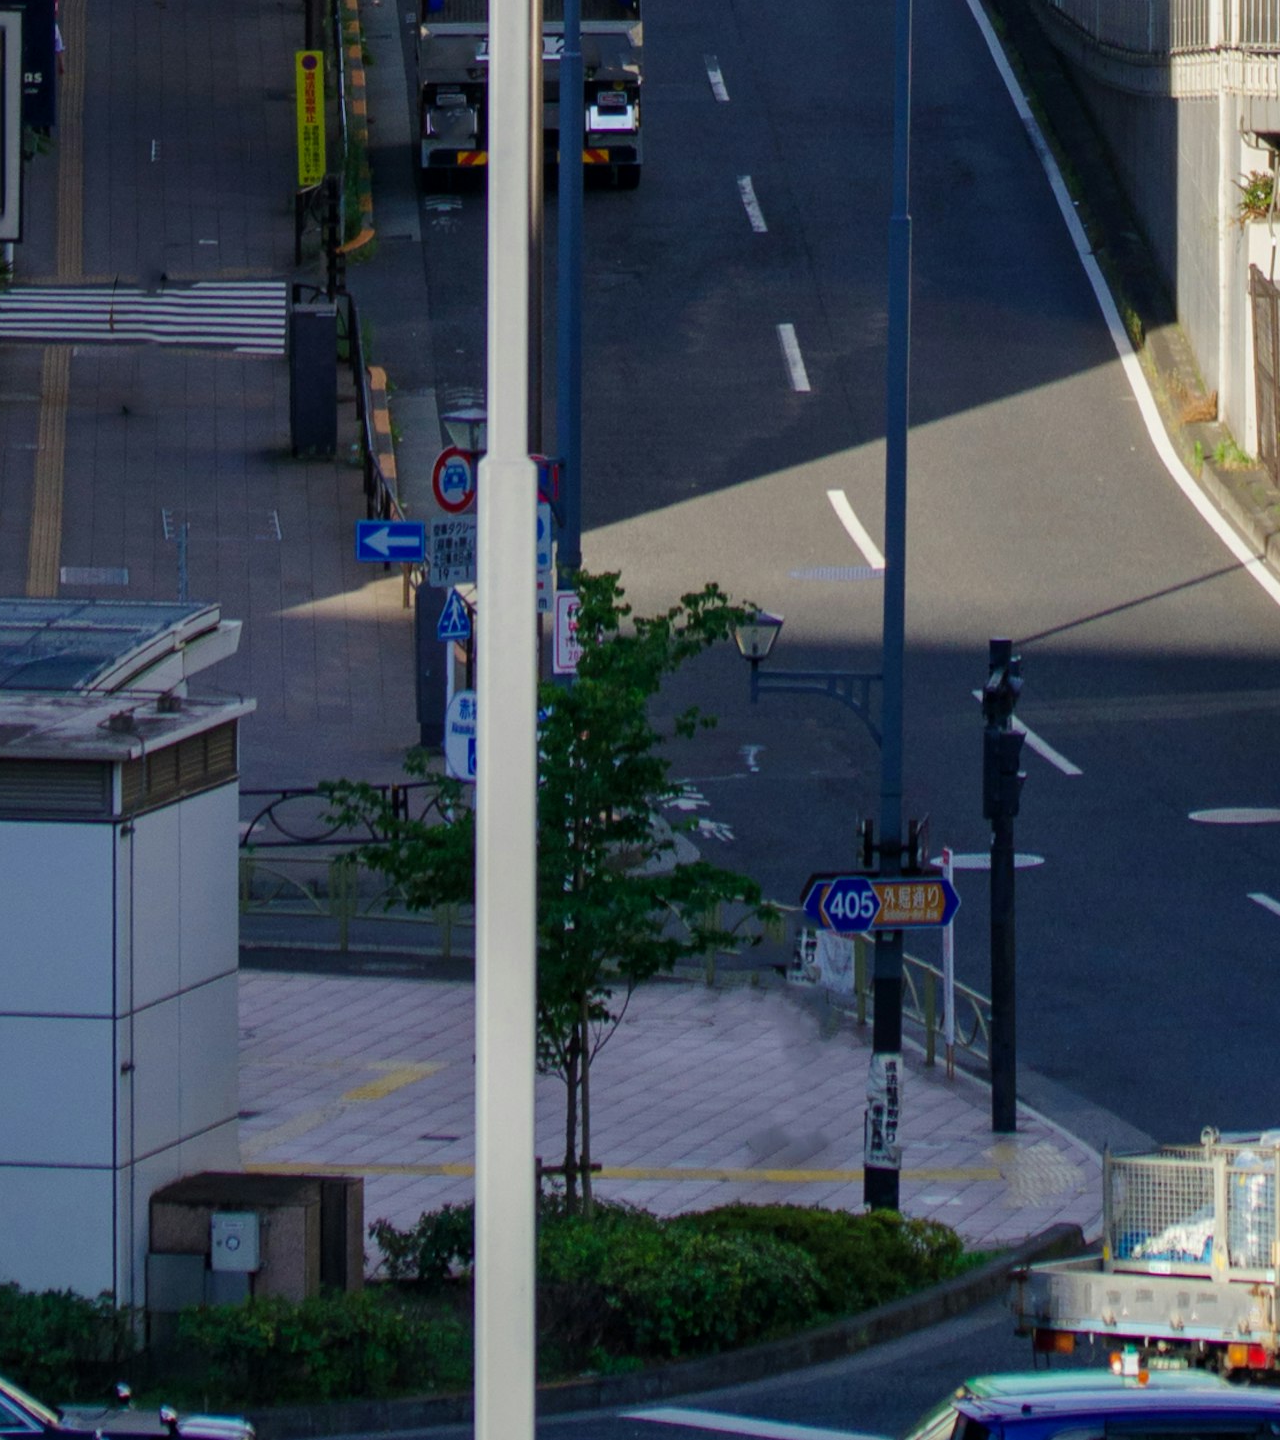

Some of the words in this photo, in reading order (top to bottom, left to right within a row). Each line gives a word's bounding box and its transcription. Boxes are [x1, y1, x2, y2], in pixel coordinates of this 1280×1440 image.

[830, 891, 875, 920] 405
[883, 882, 940, 910] 外堀通り
